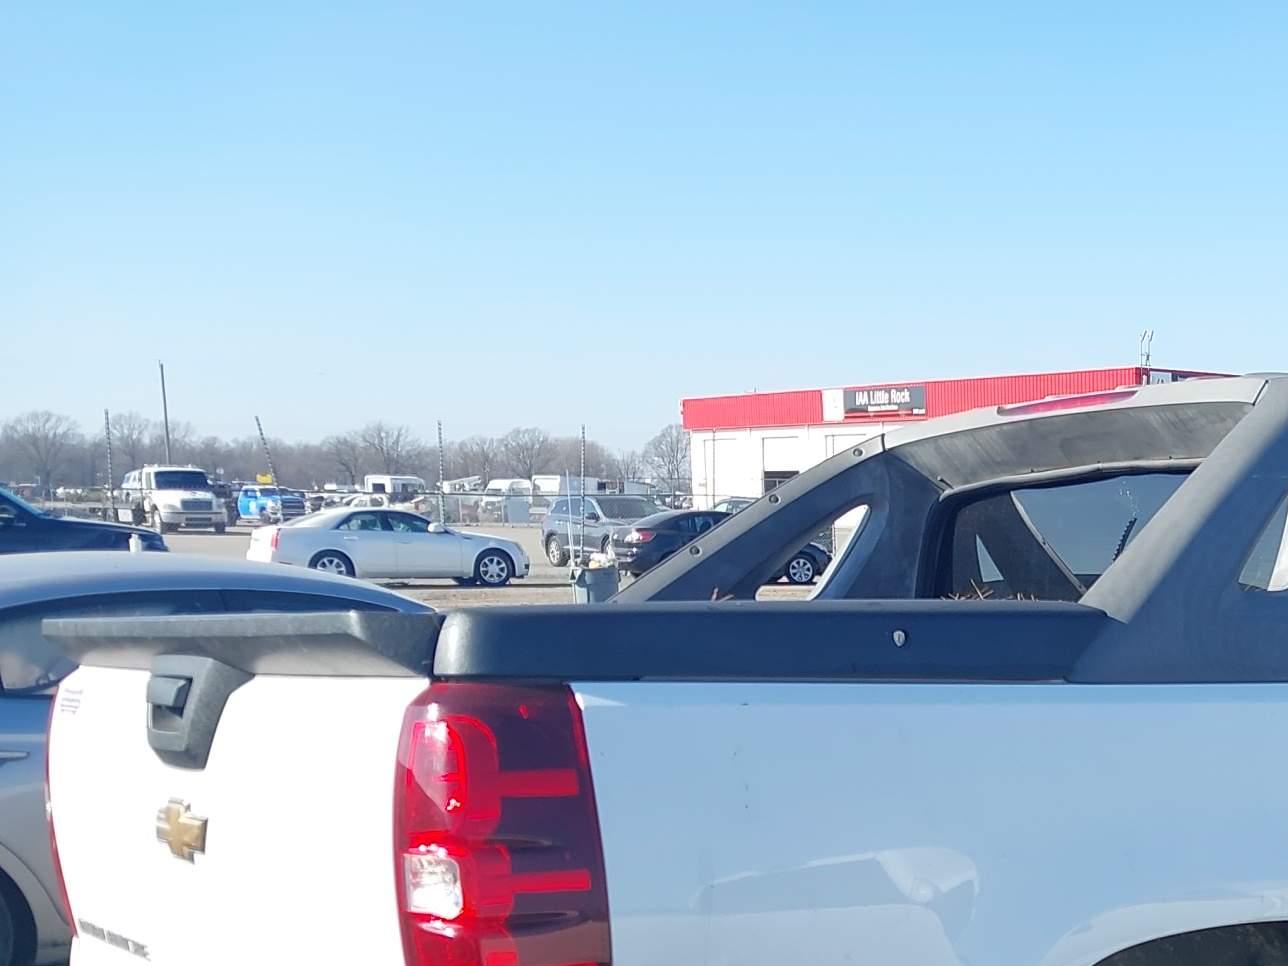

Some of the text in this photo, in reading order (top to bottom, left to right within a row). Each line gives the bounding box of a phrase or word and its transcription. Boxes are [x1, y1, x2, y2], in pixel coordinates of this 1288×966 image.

[855, 388, 910, 405] IAA Little Rock
